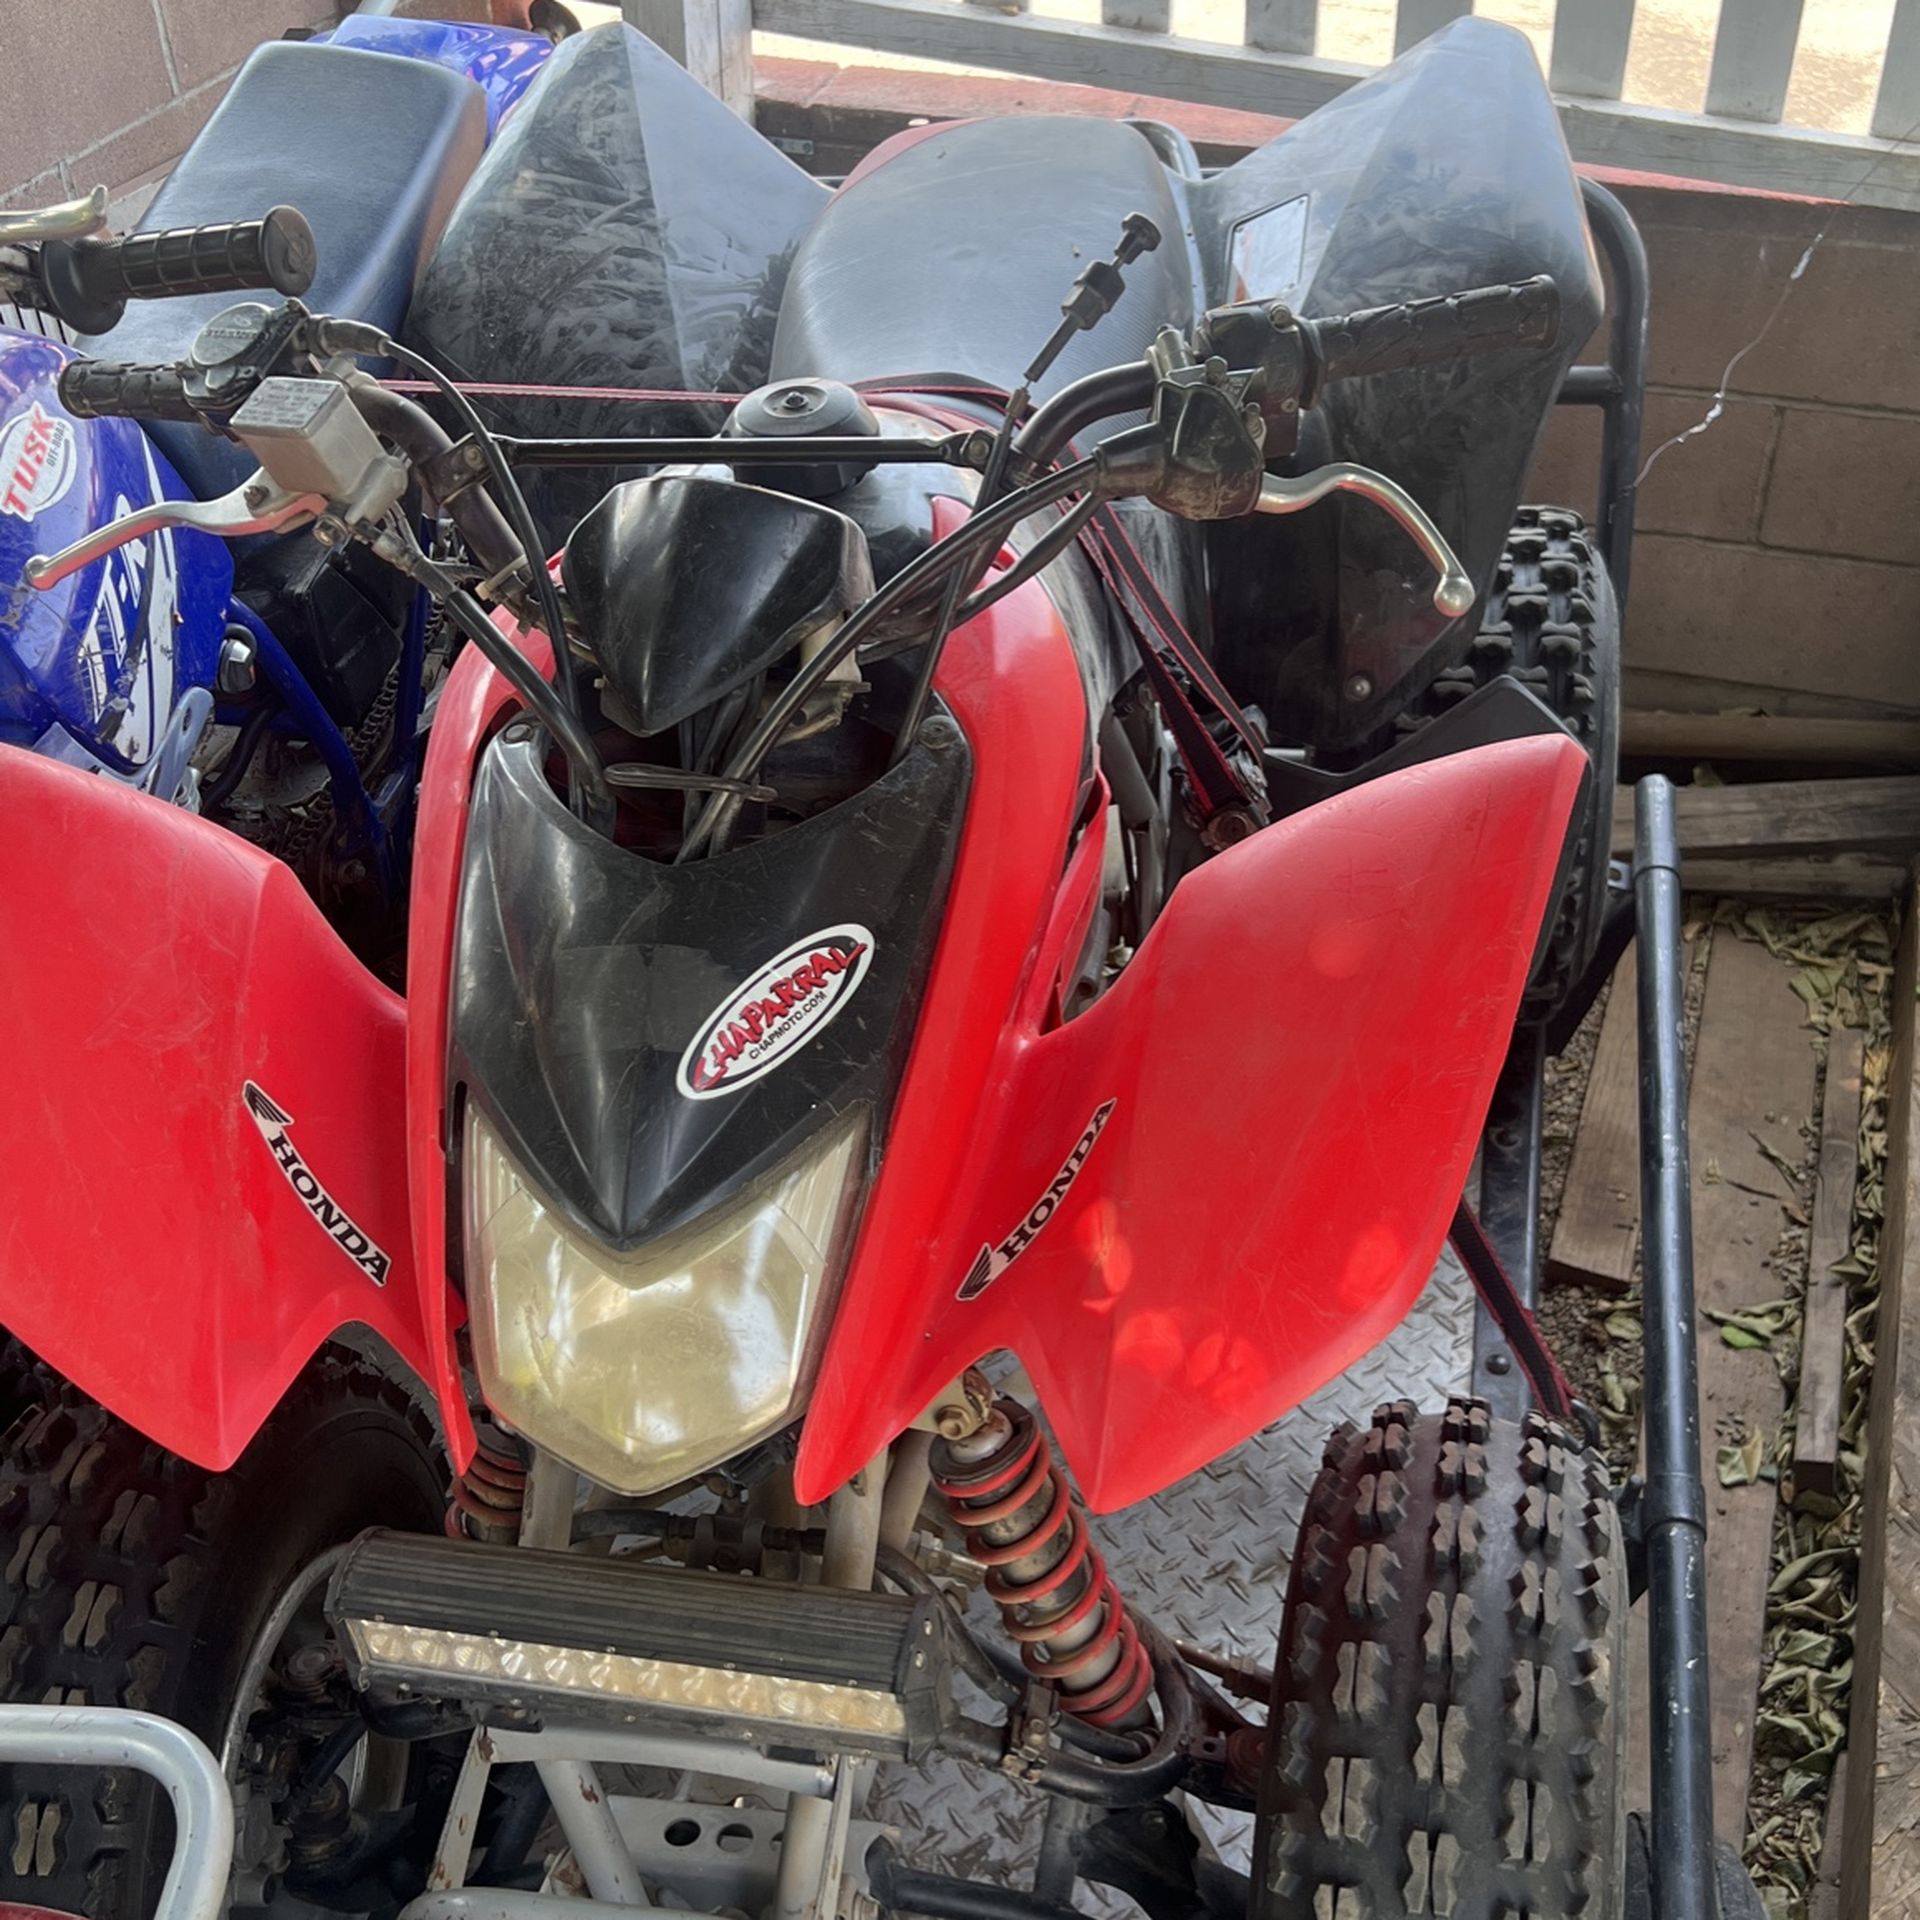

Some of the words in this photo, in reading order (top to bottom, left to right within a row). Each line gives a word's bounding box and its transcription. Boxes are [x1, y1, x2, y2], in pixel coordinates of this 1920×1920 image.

[3, 402, 55, 516] TUSK
[46, 421, 67, 467] OFF-ROAD
[692, 942, 868, 1093] CHAPARRAL
[749, 990, 828, 1060] CHAPMOTO.COM
[268, 1130, 390, 1285] HONDA
[997, 1101, 1116, 1263] HONDA
